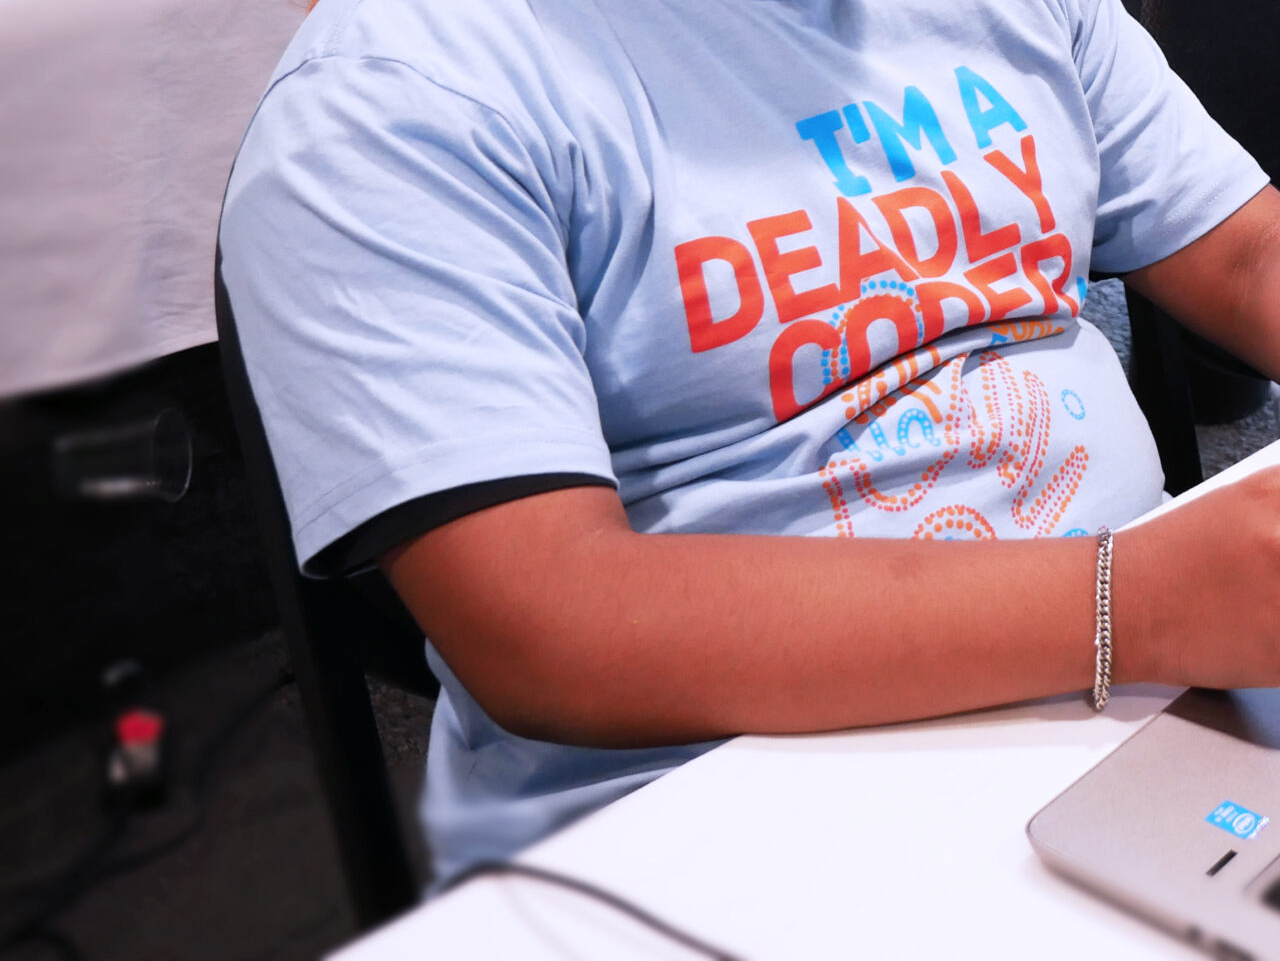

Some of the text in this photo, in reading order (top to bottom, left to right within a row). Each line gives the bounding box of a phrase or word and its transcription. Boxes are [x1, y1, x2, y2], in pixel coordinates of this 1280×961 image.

[795, 65, 1028, 197] I'M A
[674, 135, 1056, 354] DEADLY
